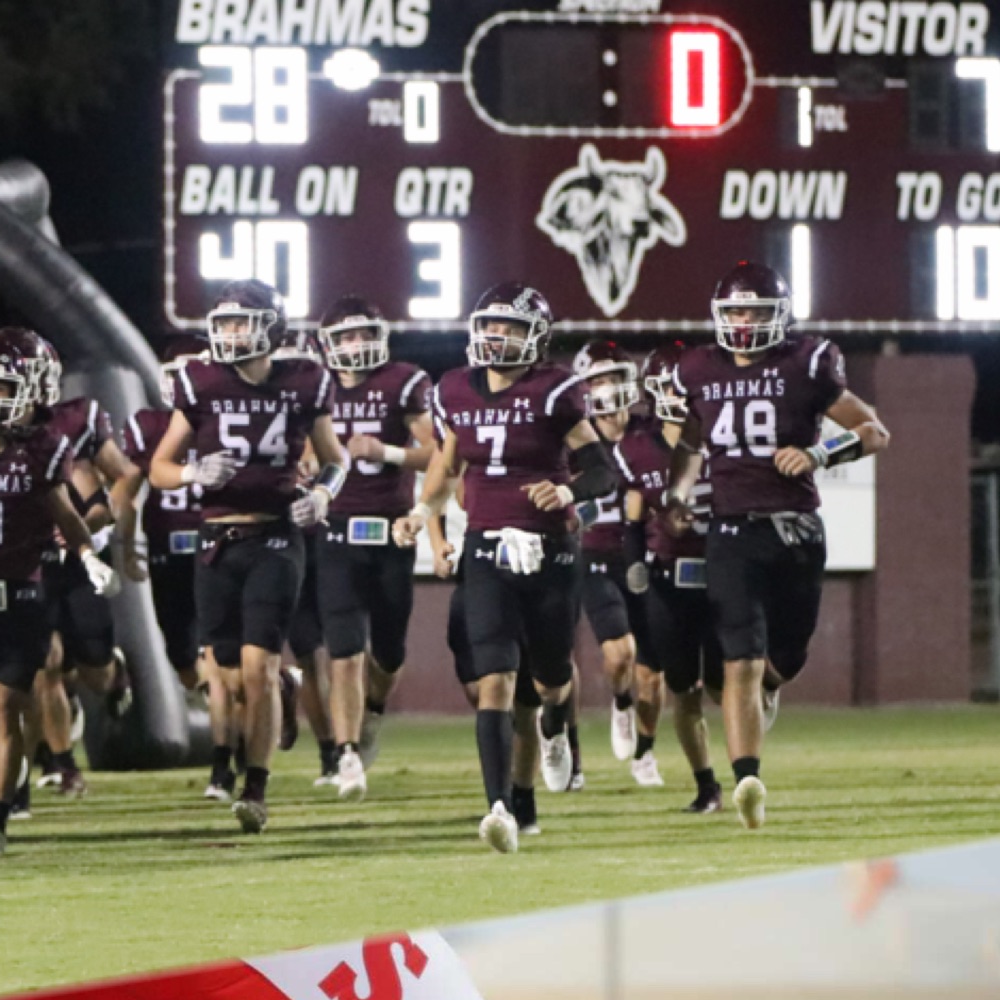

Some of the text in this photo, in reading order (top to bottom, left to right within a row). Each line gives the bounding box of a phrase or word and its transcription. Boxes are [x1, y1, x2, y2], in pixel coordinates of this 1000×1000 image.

[176, 0, 431, 46] BRAHMAS
[810, 1, 990, 55] VISITOR
[198, 46, 308, 144] 28
[404, 81, 440, 143] 0
[799, 87, 812, 146] 1
[814, 107, 847, 131] TOL
[181, 165, 358, 216] BALL ON
[394, 168, 473, 216] QTR
[720, 170, 847, 219] DOWN
[896, 172, 941, 220] TO
[408, 222, 461, 319] 3
[791, 225, 811, 319] 1
[937, 225, 1000, 320] 10
[333, 402, 388, 419] AHMAS
[702, 379, 785, 401] BRAHMAS
[219, 412, 288, 468] 54
[476, 426, 507, 475] 7
[711, 400, 777, 457] 48
